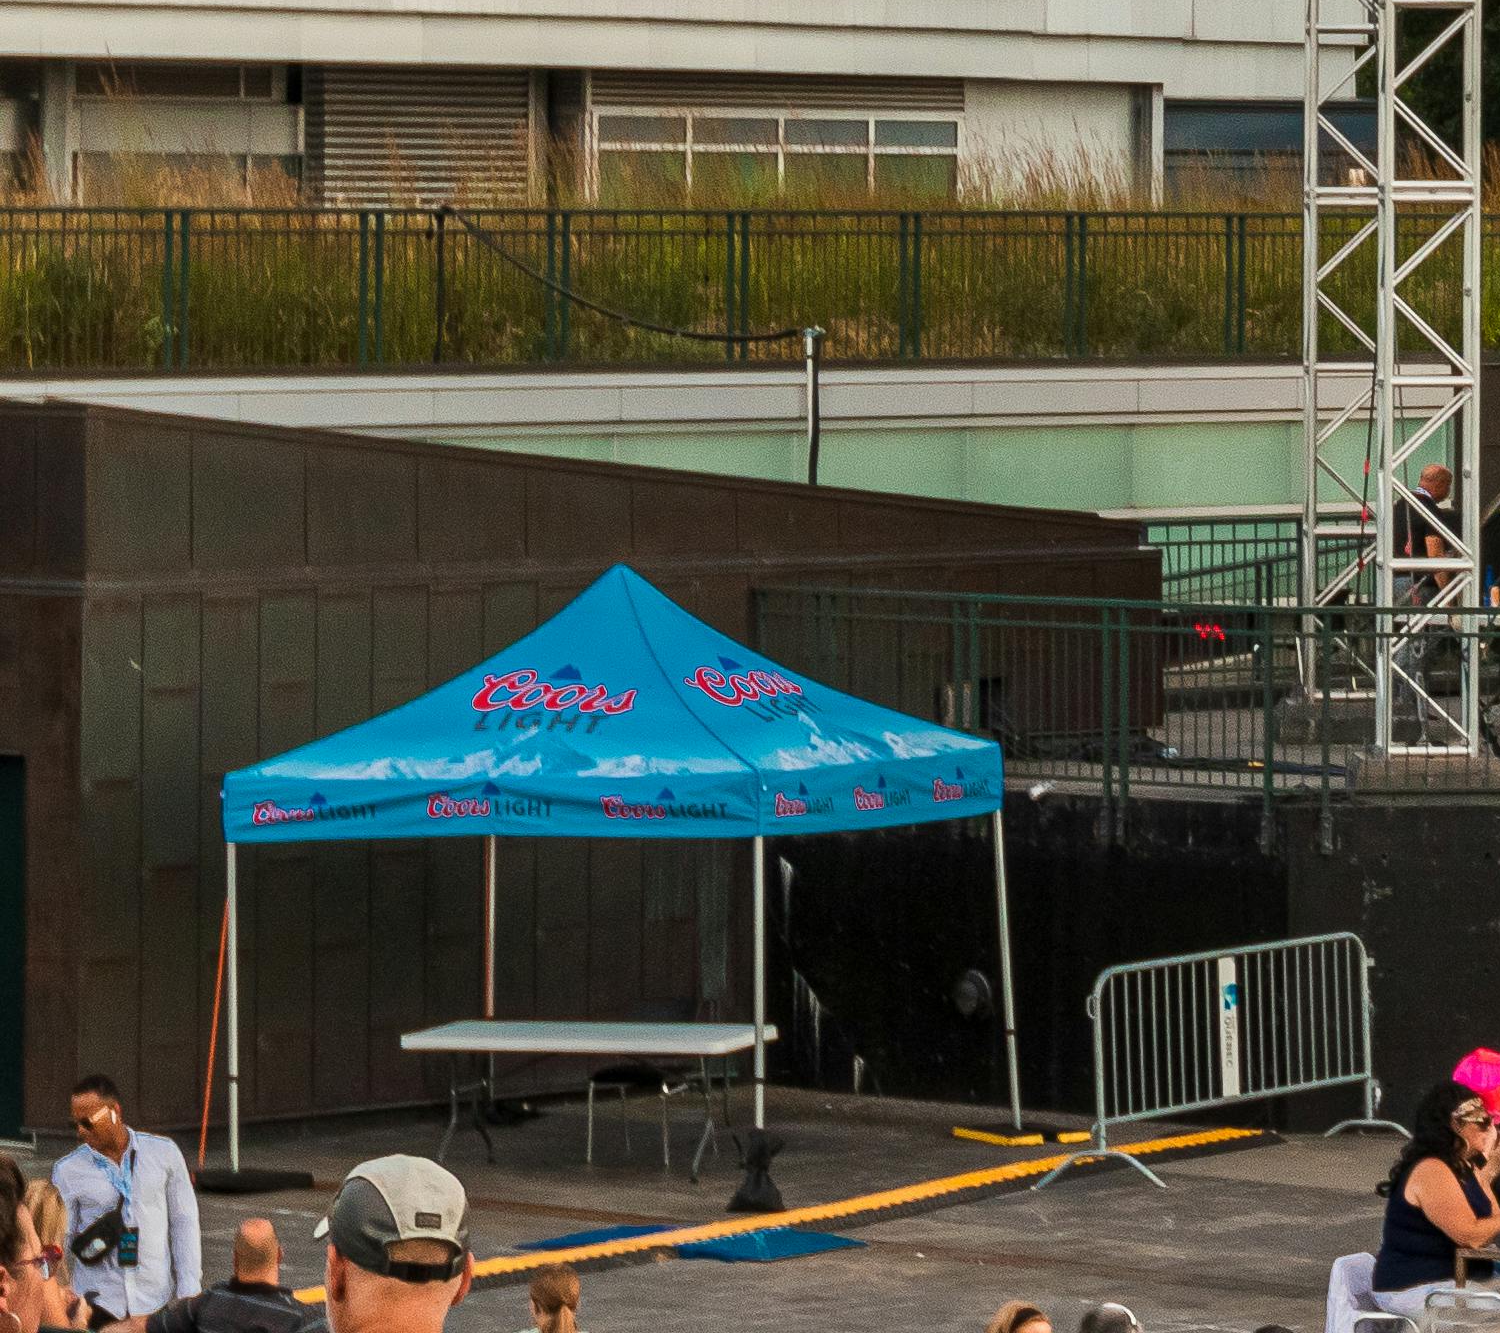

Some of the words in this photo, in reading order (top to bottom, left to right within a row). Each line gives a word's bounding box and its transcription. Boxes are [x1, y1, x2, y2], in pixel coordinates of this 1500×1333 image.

[472, 668, 637, 715] Coors
[685, 666, 803, 707] Coors
[473, 711, 609, 733] LIGHT
[426, 792, 490, 818] Coors
[494, 798, 551, 817] LIGHT
[600, 795, 666, 819] Coors
[669, 802, 728, 819] LIGHT
